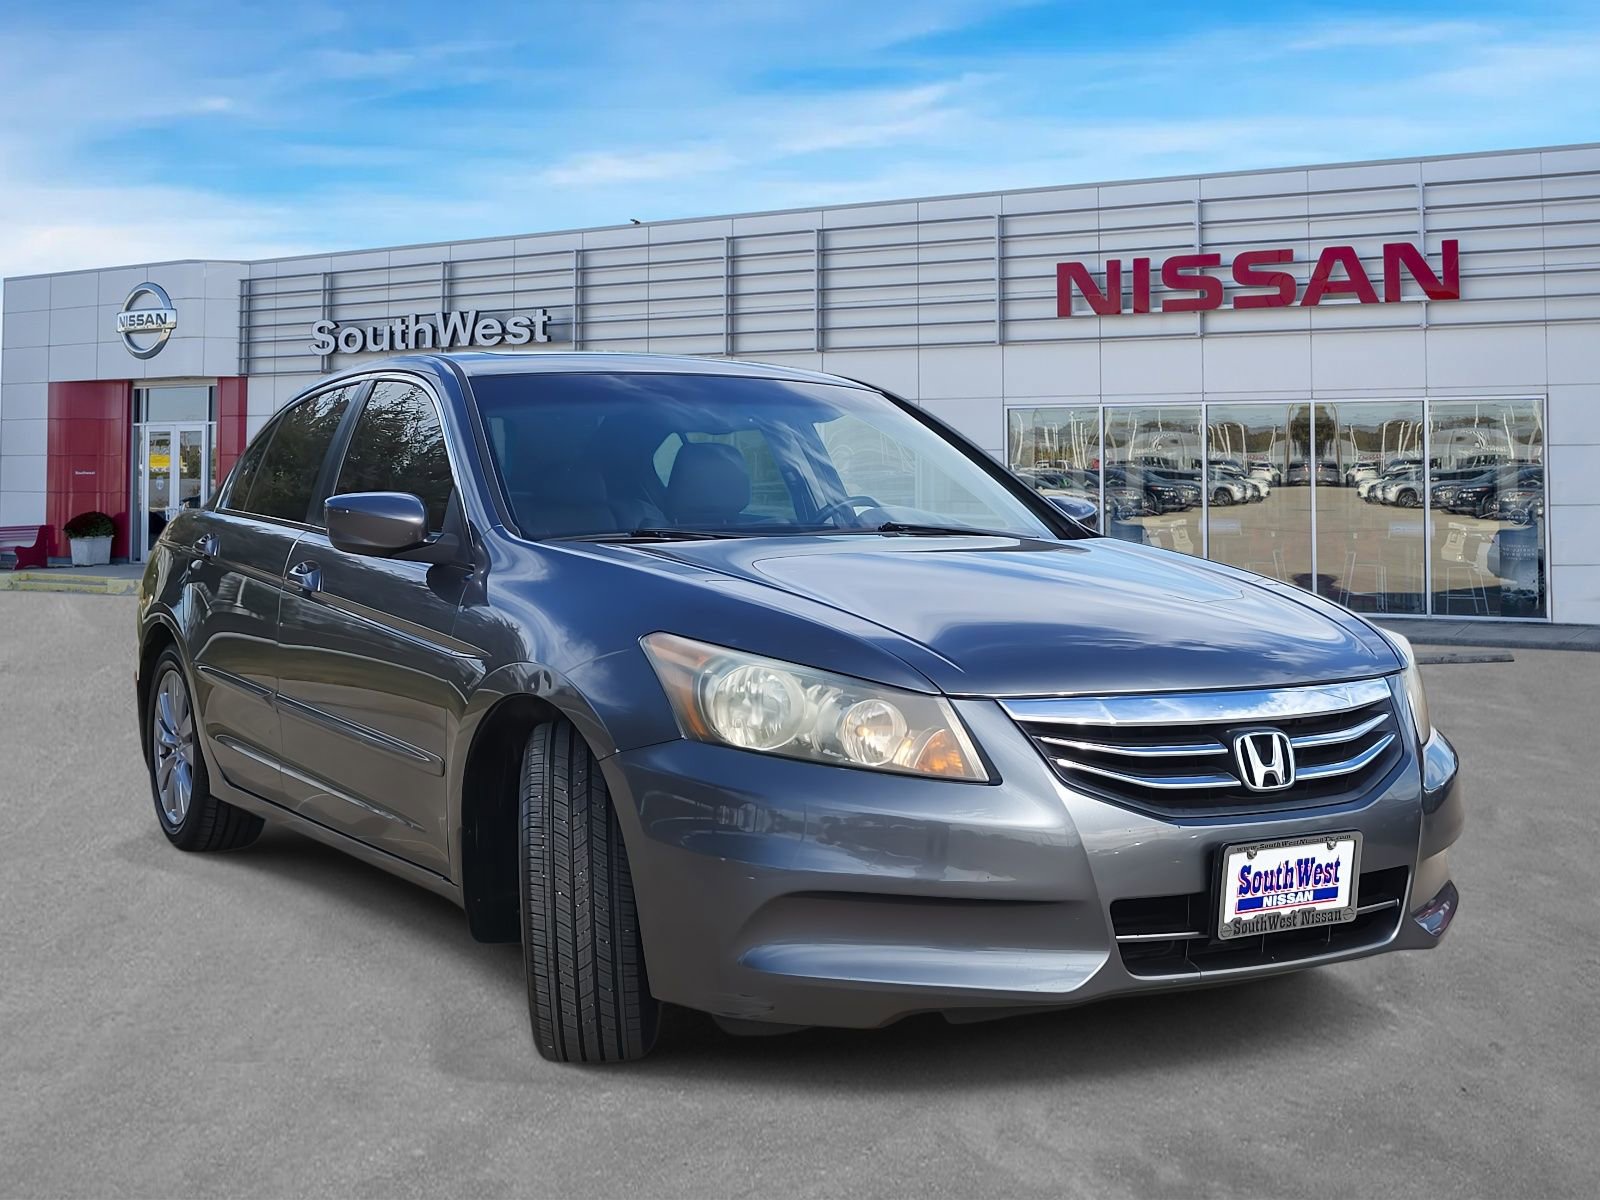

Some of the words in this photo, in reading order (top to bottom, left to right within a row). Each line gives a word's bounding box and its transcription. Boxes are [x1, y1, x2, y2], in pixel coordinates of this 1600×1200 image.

[1056, 239, 1461, 318] NISSAN
[119, 312, 167, 328] NISSAN
[309, 308, 552, 356] SouthWest
[1262, 890, 1314, 908] NISSAN
[1233, 912, 1298, 935] SouthWest
[1301, 909, 1342, 928] Nissan
